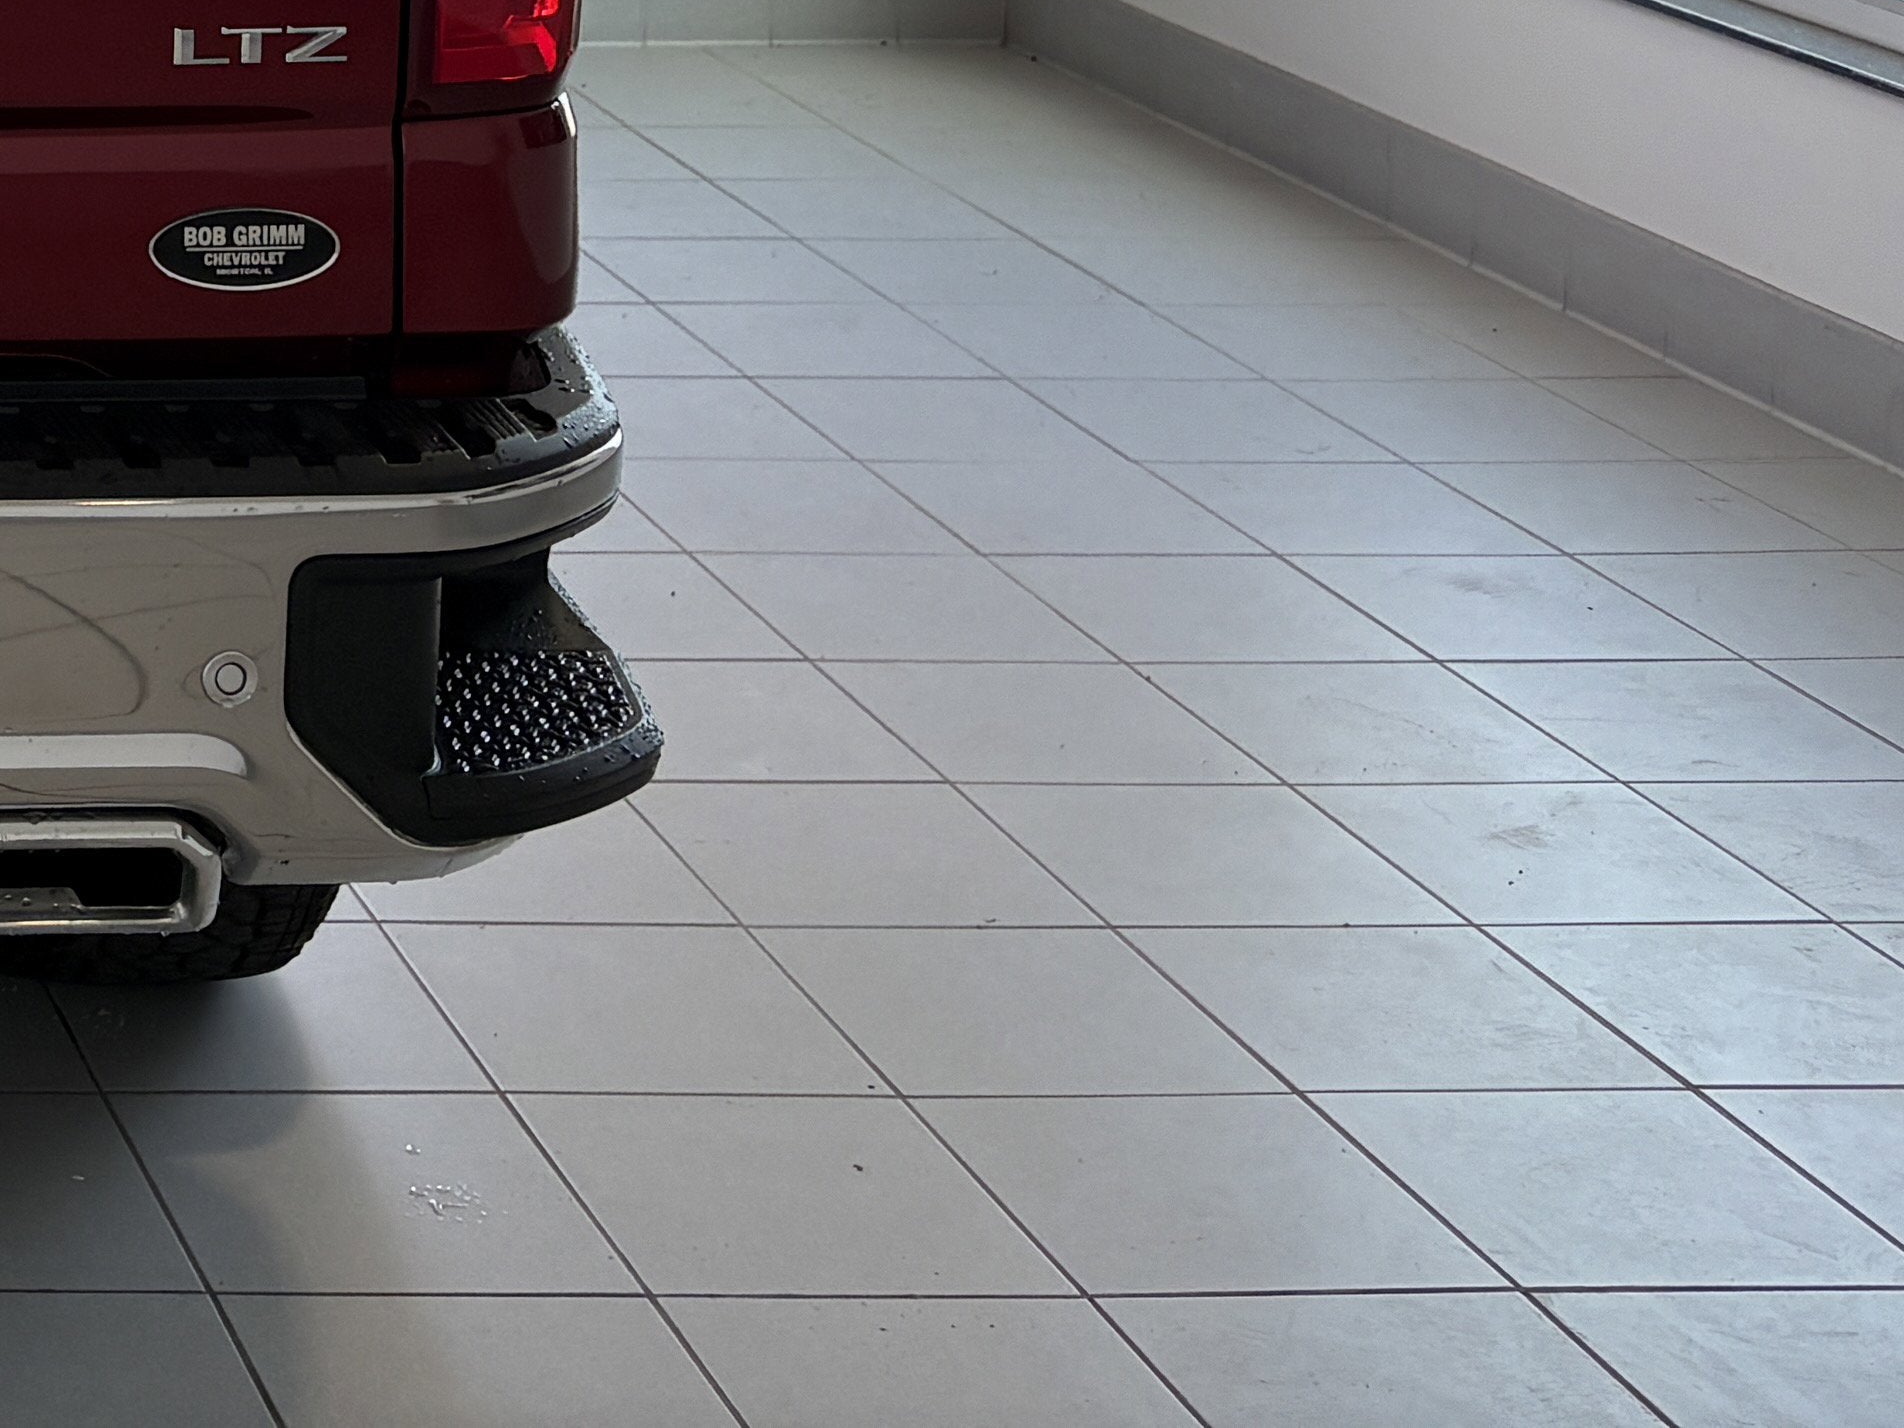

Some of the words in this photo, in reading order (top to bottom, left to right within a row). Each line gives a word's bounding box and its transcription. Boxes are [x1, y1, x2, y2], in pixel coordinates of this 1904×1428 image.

[173, 25, 348, 66] LTZ
[183, 226, 227, 246] BOB
[233, 224, 305, 245] GRIMM
[203, 252, 286, 266] CHEVROLET
